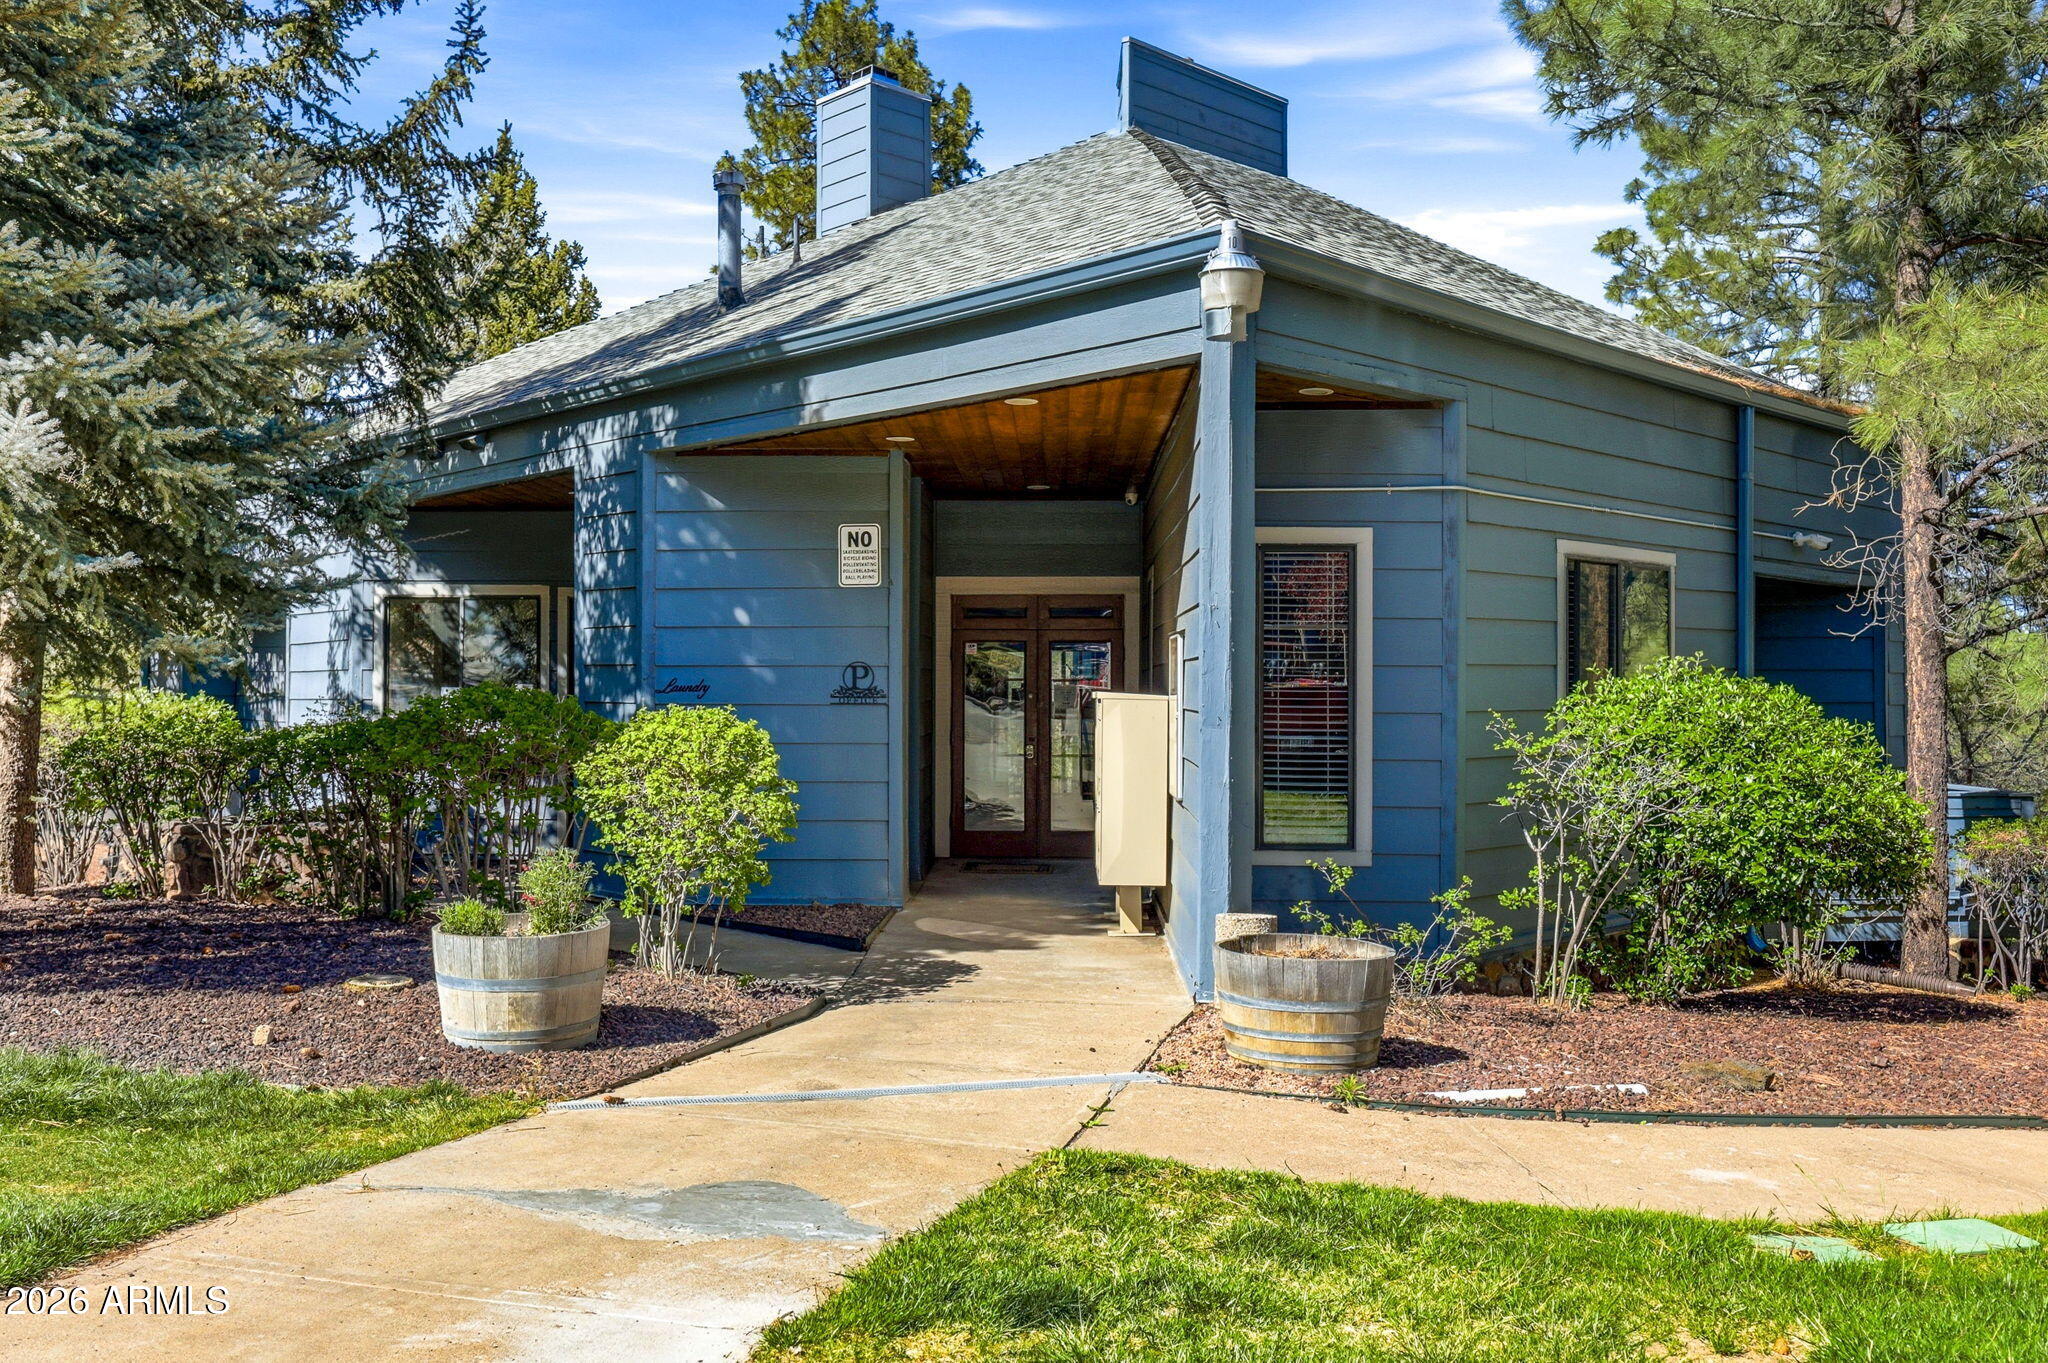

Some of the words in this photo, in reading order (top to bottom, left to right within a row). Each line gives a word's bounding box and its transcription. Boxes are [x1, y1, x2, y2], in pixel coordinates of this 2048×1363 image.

[1228, 236, 1238, 248] 10
[847, 531, 872, 548] NO
[850, 665, 870, 689] P
[655, 677, 711, 700] Laundry
